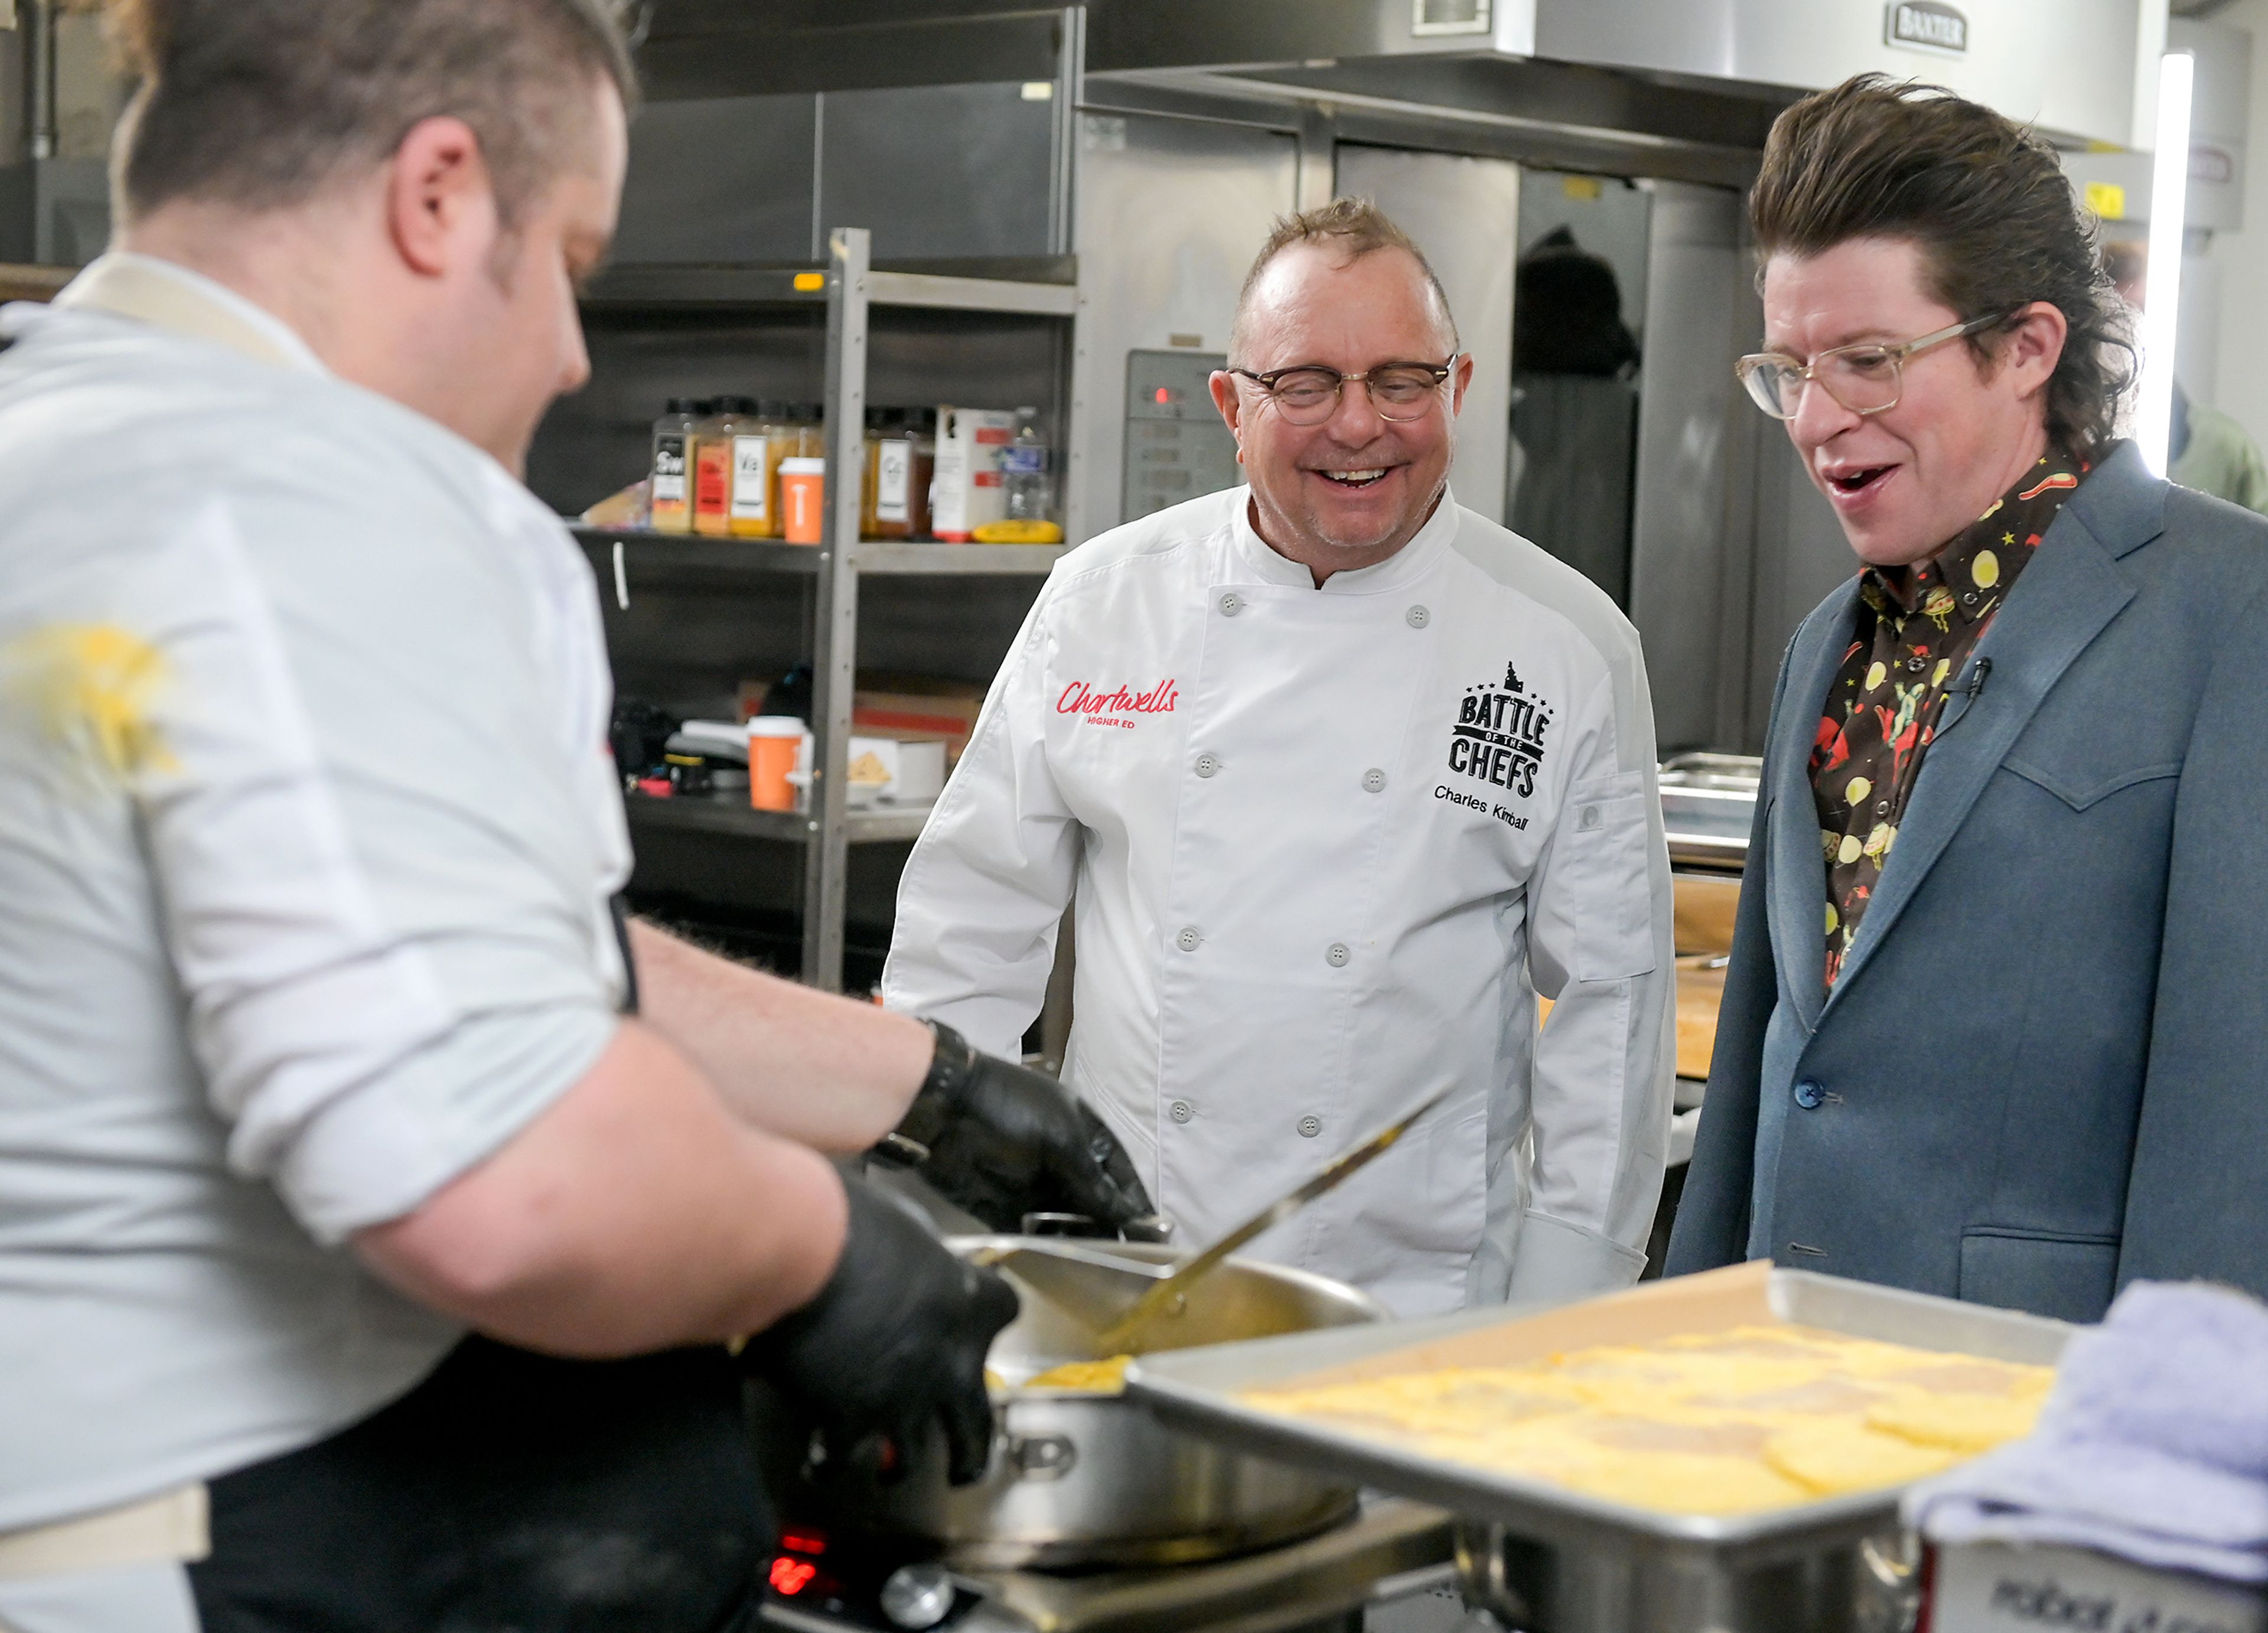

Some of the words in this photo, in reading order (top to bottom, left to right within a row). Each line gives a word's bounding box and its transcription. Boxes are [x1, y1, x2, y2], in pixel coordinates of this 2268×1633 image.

[1898, 5, 1964, 45] BAXTER
[1056, 679, 1179, 714] Chartwells
[1087, 716, 1120, 726] HIGHER
[1122, 720, 1135, 729] ED
[1458, 693, 1550, 747] BATTLE
[1485, 732, 1498, 741] OF
[1504, 736, 1523, 749] THE
[1448, 738, 1539, 798] CHEFS
[1434, 785, 1488, 813] Charles
[1492, 804, 1529, 831] Kimball
